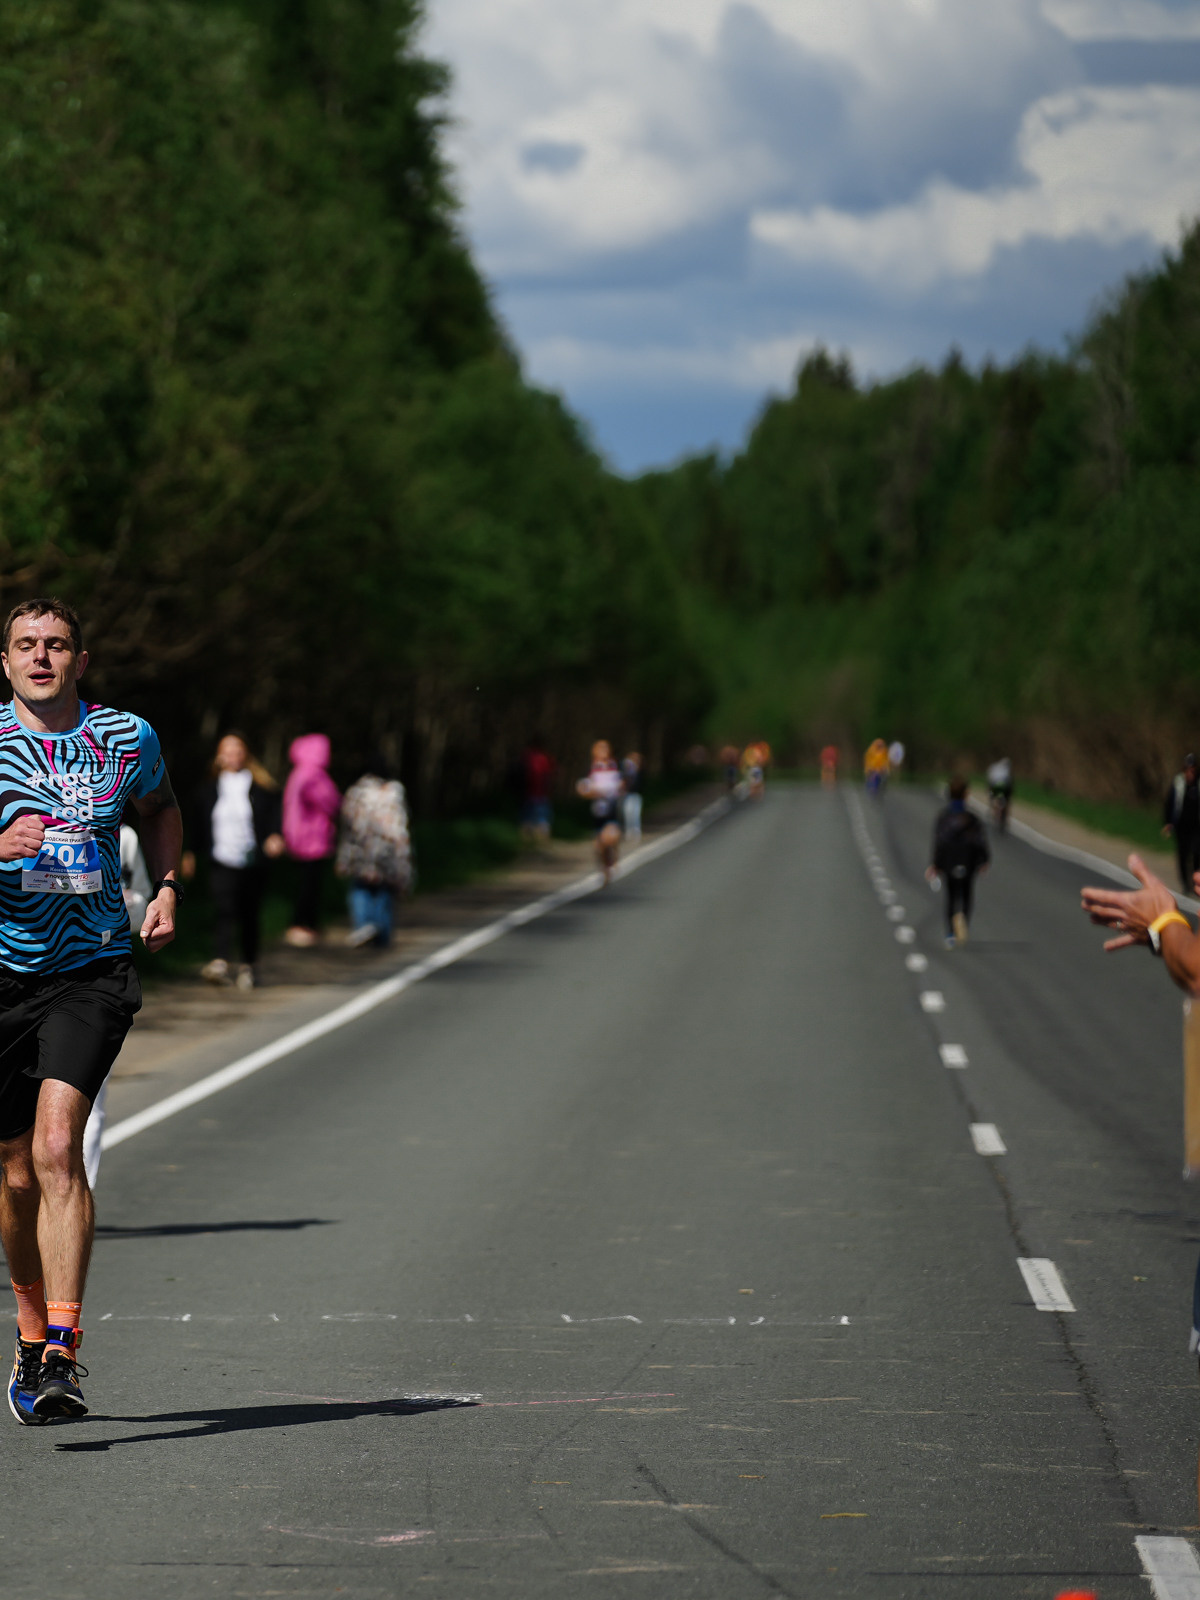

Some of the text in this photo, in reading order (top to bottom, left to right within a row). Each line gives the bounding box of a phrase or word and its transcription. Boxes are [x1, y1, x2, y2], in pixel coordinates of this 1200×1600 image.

[26, 770, 93, 788] #nov
[61, 786, 93, 806] go
[51, 798, 94, 820] rod
[40, 843, 88, 867] 204
